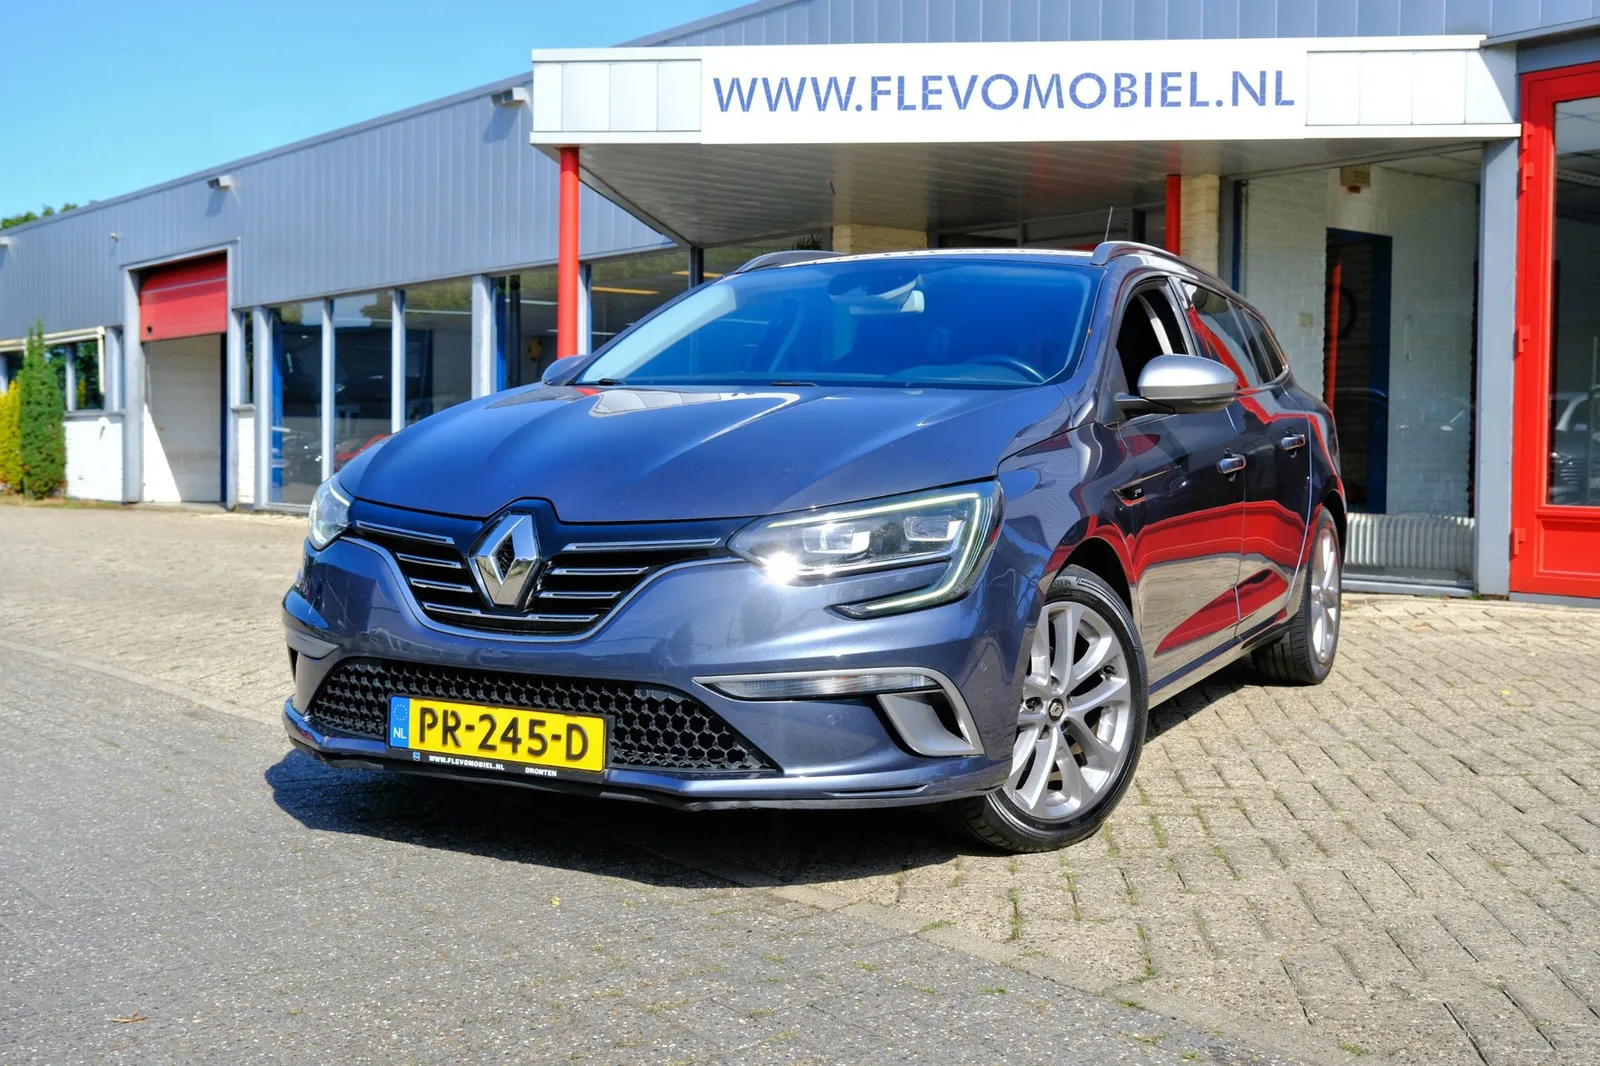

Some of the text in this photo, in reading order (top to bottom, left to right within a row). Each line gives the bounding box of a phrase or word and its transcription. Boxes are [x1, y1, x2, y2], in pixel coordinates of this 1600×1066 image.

[713, 70, 1295, 112] WWW.FLEVOMOBIEL.NL
[393, 727, 407, 739] NL
[419, 706, 589, 761] PR-245-D
[429, 755, 505, 770] WWW.FLEVOMOBIEL.NL
[525, 767, 557, 776] DRONTEN
